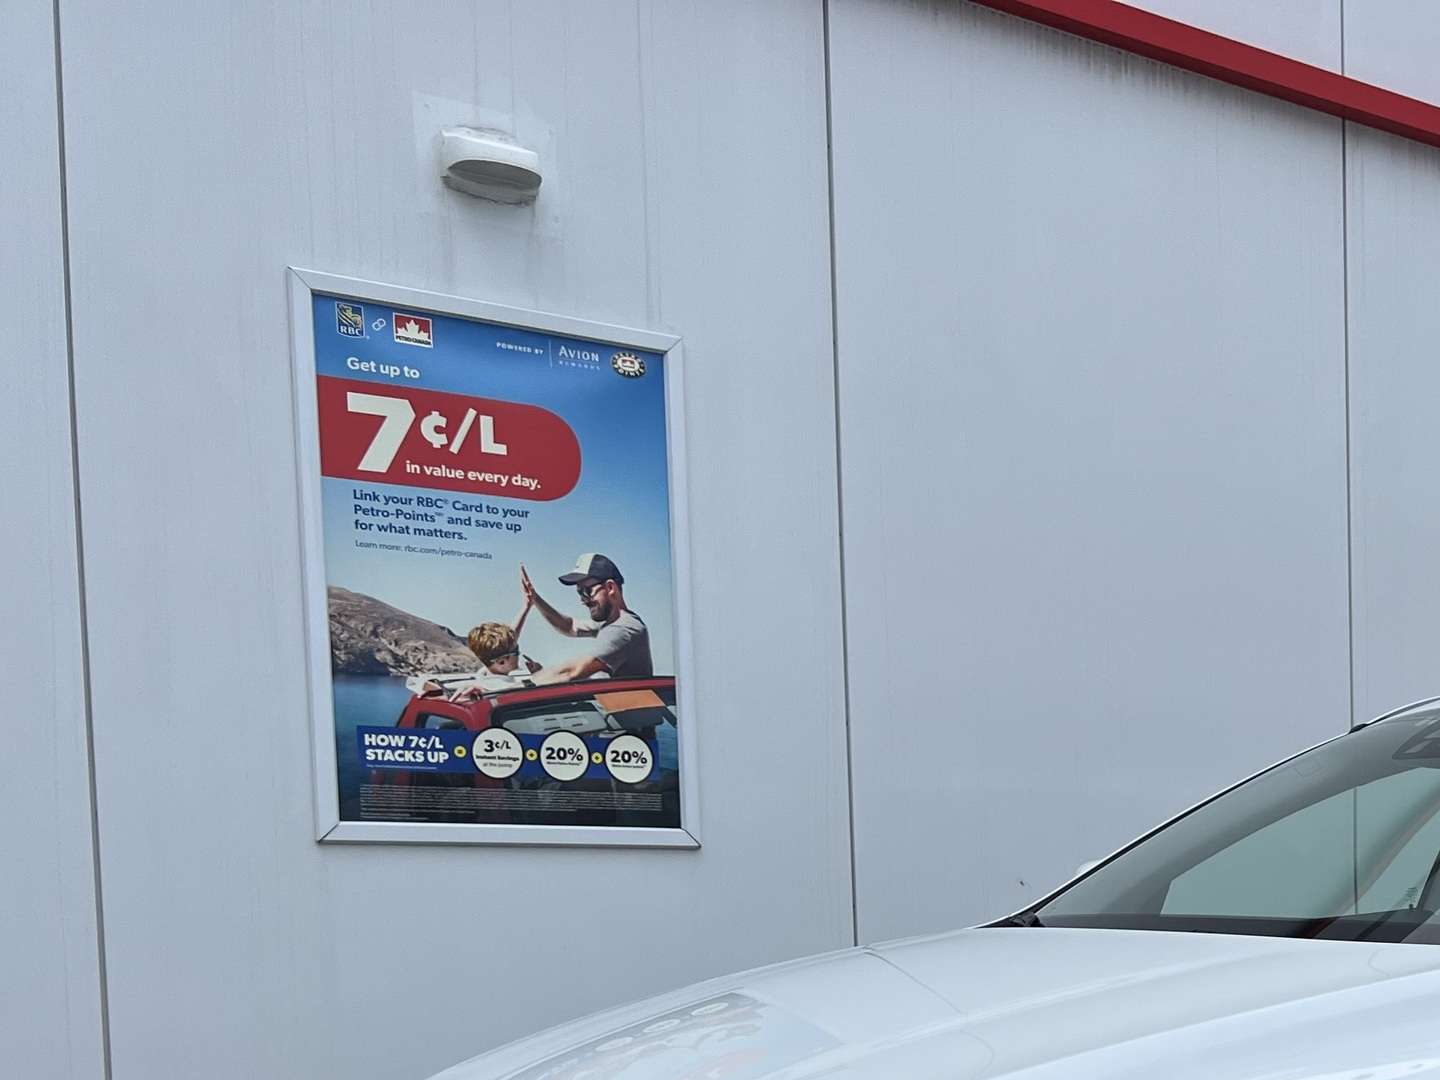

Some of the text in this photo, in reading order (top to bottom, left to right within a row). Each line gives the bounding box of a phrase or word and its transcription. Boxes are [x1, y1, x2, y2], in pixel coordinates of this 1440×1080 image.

[340, 325, 361, 336] RBC
[496, 342, 532, 353] POWERED
[559, 345, 600, 362] AVION
[347, 356, 420, 378] Get up to
[405, 460, 541, 490] in value every day.
[353, 489, 380, 502] Link
[383, 494, 414, 506] your
[452, 500, 483, 513] Card
[486, 503, 499, 515] to
[502, 507, 530, 519] your
[355, 519, 468, 541] for what matters.
[447, 515, 472, 527] and
[475, 517, 503, 530] save
[506, 522, 522, 534] up
[355, 540, 493, 560] Learn more: rbc.com/petro-canada
[364, 733, 444, 749] HOW 7¢/L
[366, 748, 449, 763] STACKS UP
[545, 747, 583, 761] 20%
[610, 750, 648, 764] 20%
